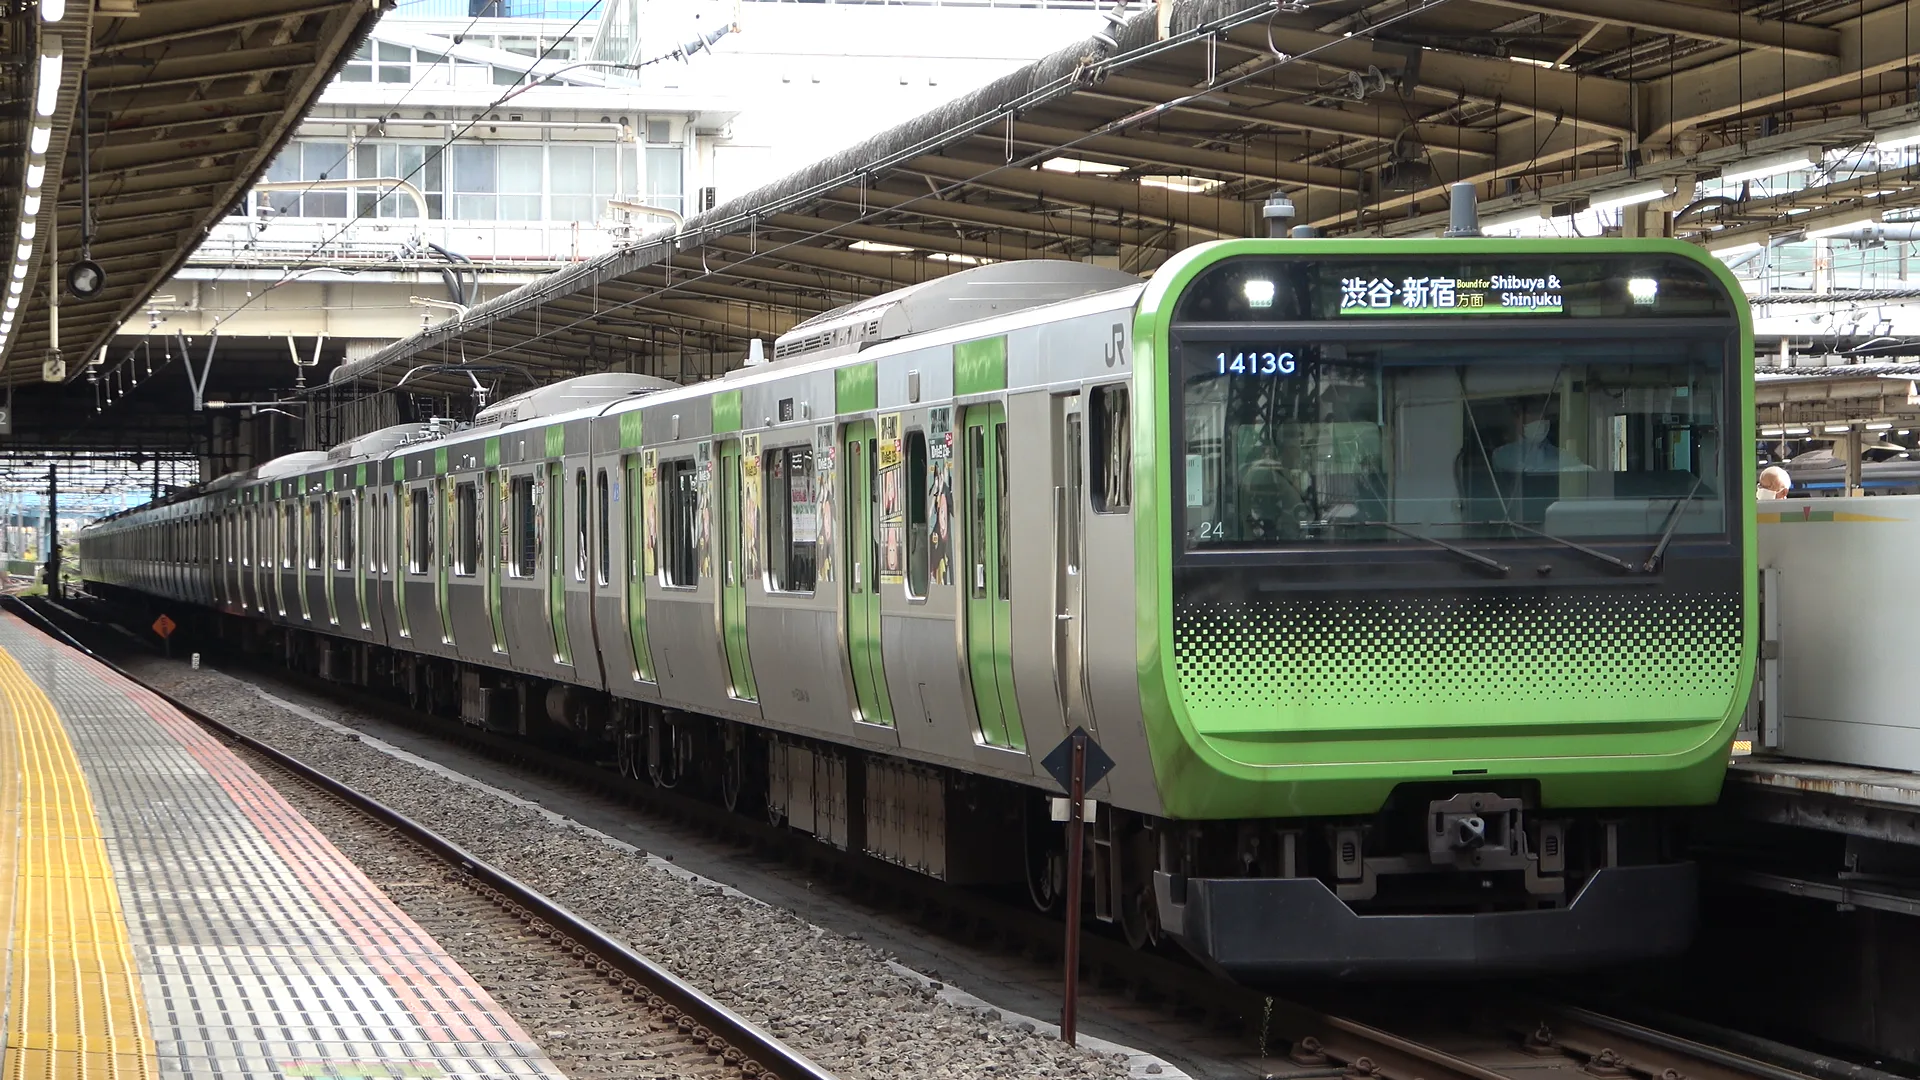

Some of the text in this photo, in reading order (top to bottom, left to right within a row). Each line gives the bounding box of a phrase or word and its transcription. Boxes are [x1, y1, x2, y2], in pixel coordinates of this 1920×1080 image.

[1456, 279, 1490, 289] Bound for
[1491, 275, 1561, 292] Shibuya &
[1456, 293, 1484, 307] 方面
[1501, 292, 1562, 309] Shinjuku
[1105, 322, 1125, 368] JR
[1217, 352, 1295, 374] 1413G
[1200, 521, 1224, 539] 24
